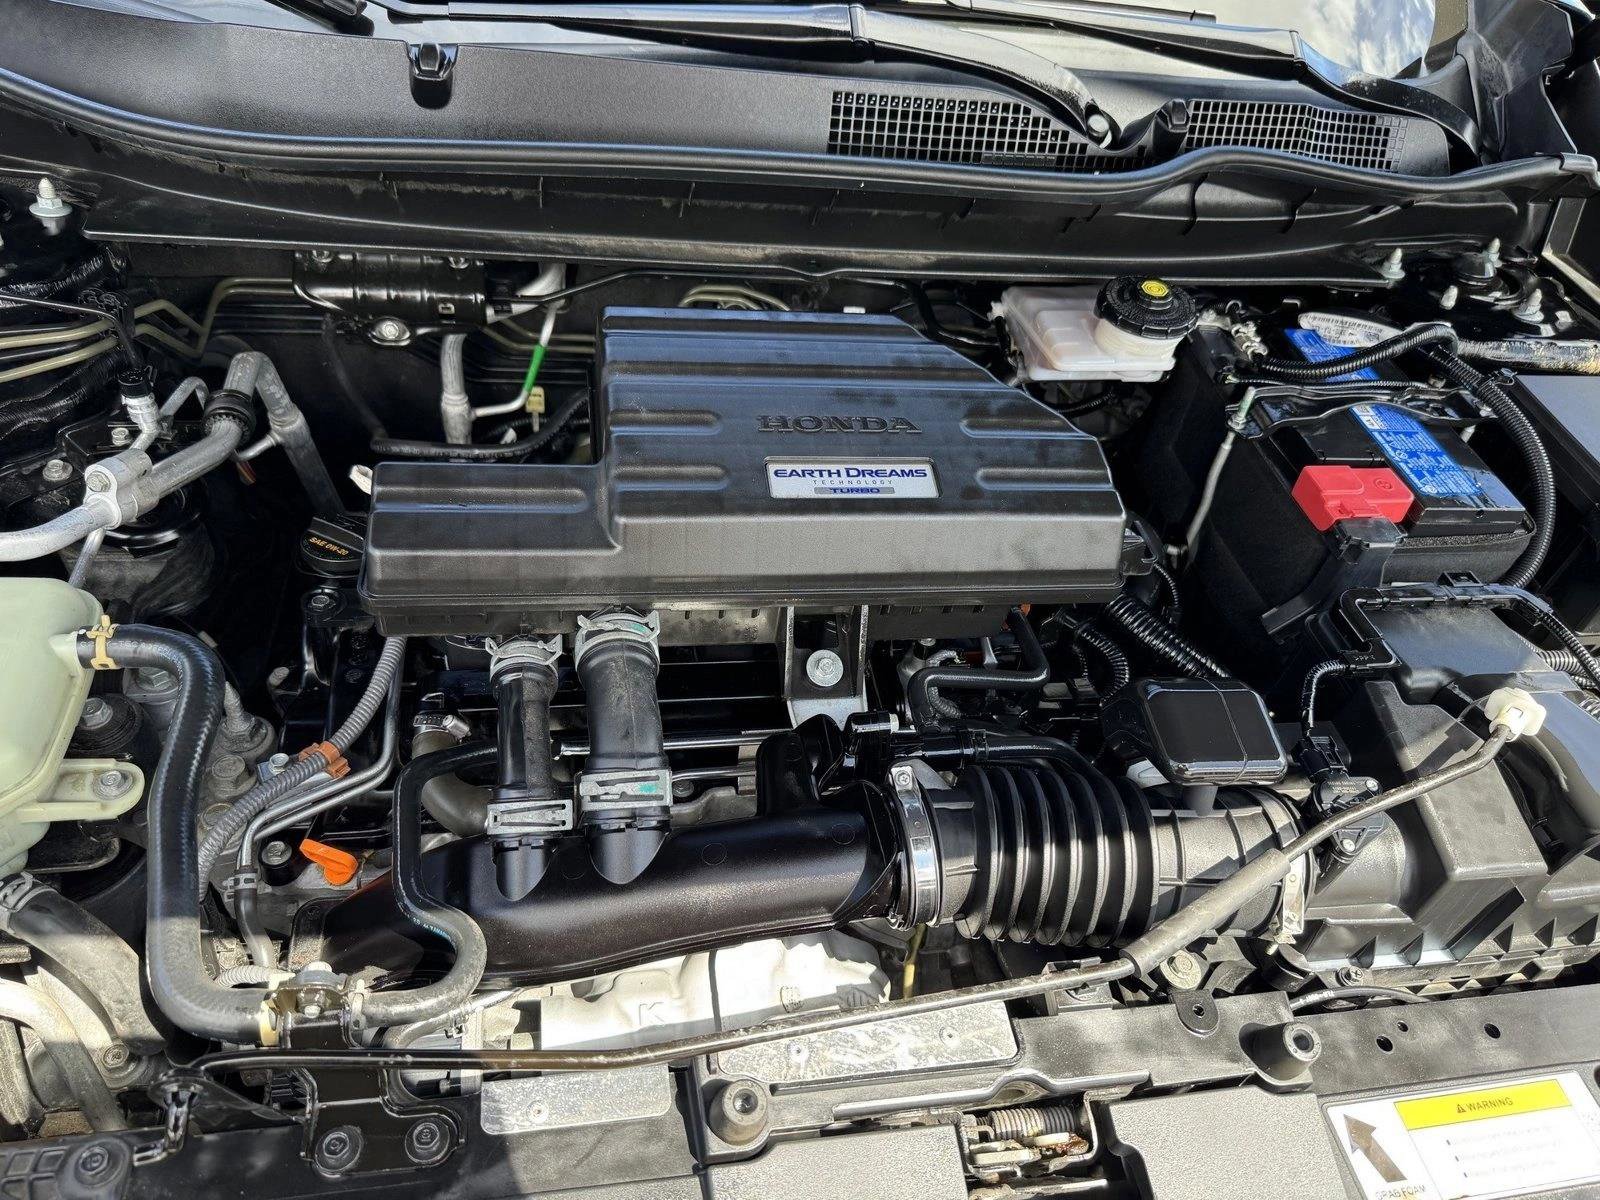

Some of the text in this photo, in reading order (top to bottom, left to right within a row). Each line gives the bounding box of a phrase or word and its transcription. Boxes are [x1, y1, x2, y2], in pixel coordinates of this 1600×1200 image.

[757, 415, 922, 434] HONDA
[774, 467, 928, 478] EARTH DREAMS
[309, 537, 349, 556] SAE 0W-20
[1466, 1097, 1513, 1112] WARNING
